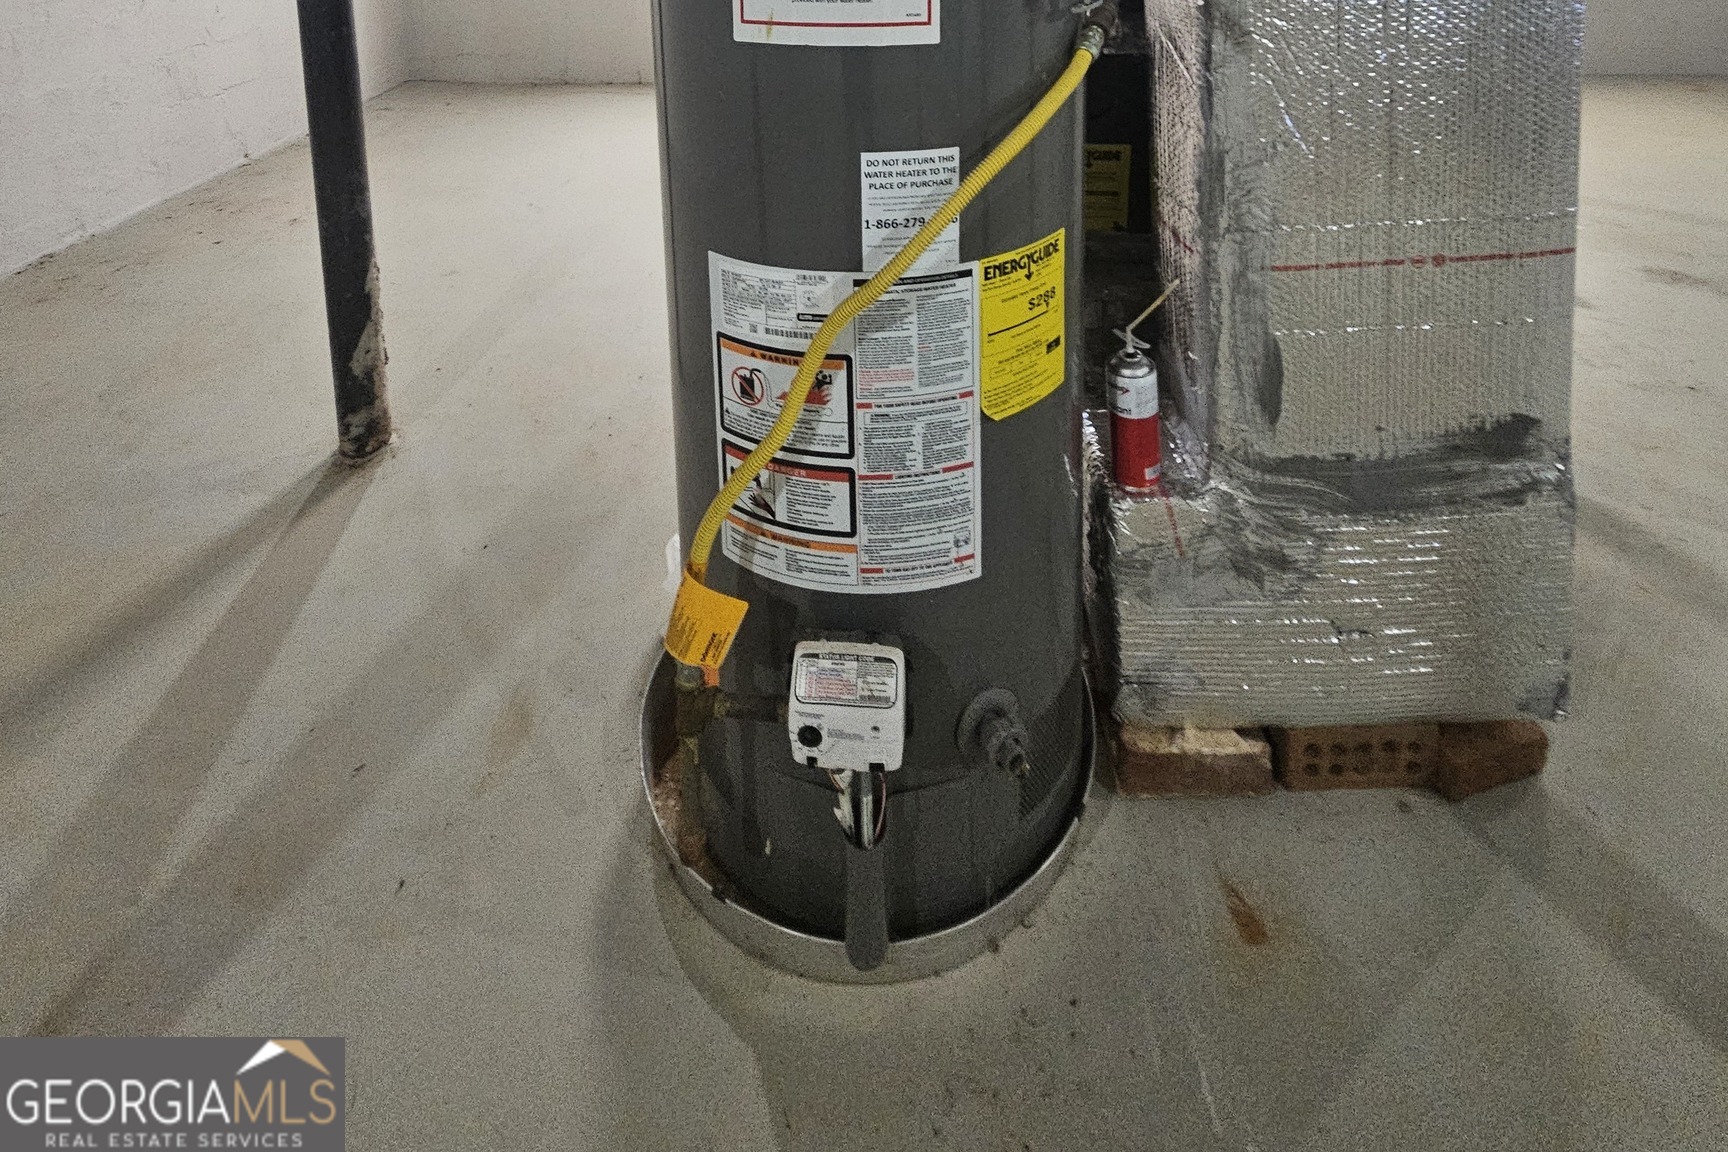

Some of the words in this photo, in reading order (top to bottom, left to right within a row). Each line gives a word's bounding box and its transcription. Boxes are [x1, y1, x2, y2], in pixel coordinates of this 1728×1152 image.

[866, 159, 880, 167] DO
[881, 158, 900, 167] NOT
[902, 156, 936, 166] RETURN
[938, 154, 955, 164] THIS
[863, 170, 894, 179] WATER
[895, 168, 927, 178] HEATER
[929, 167, 941, 176] TO
[942, 166, 958, 174] THE
[868, 181, 894, 190] PLACE
[896, 181, 908, 189] OF
[910, 178, 953, 188] PURCHASE
[983, 238, 1060, 282] ENERGYGUIDE
[760, 353, 801, 367] WARNIN
